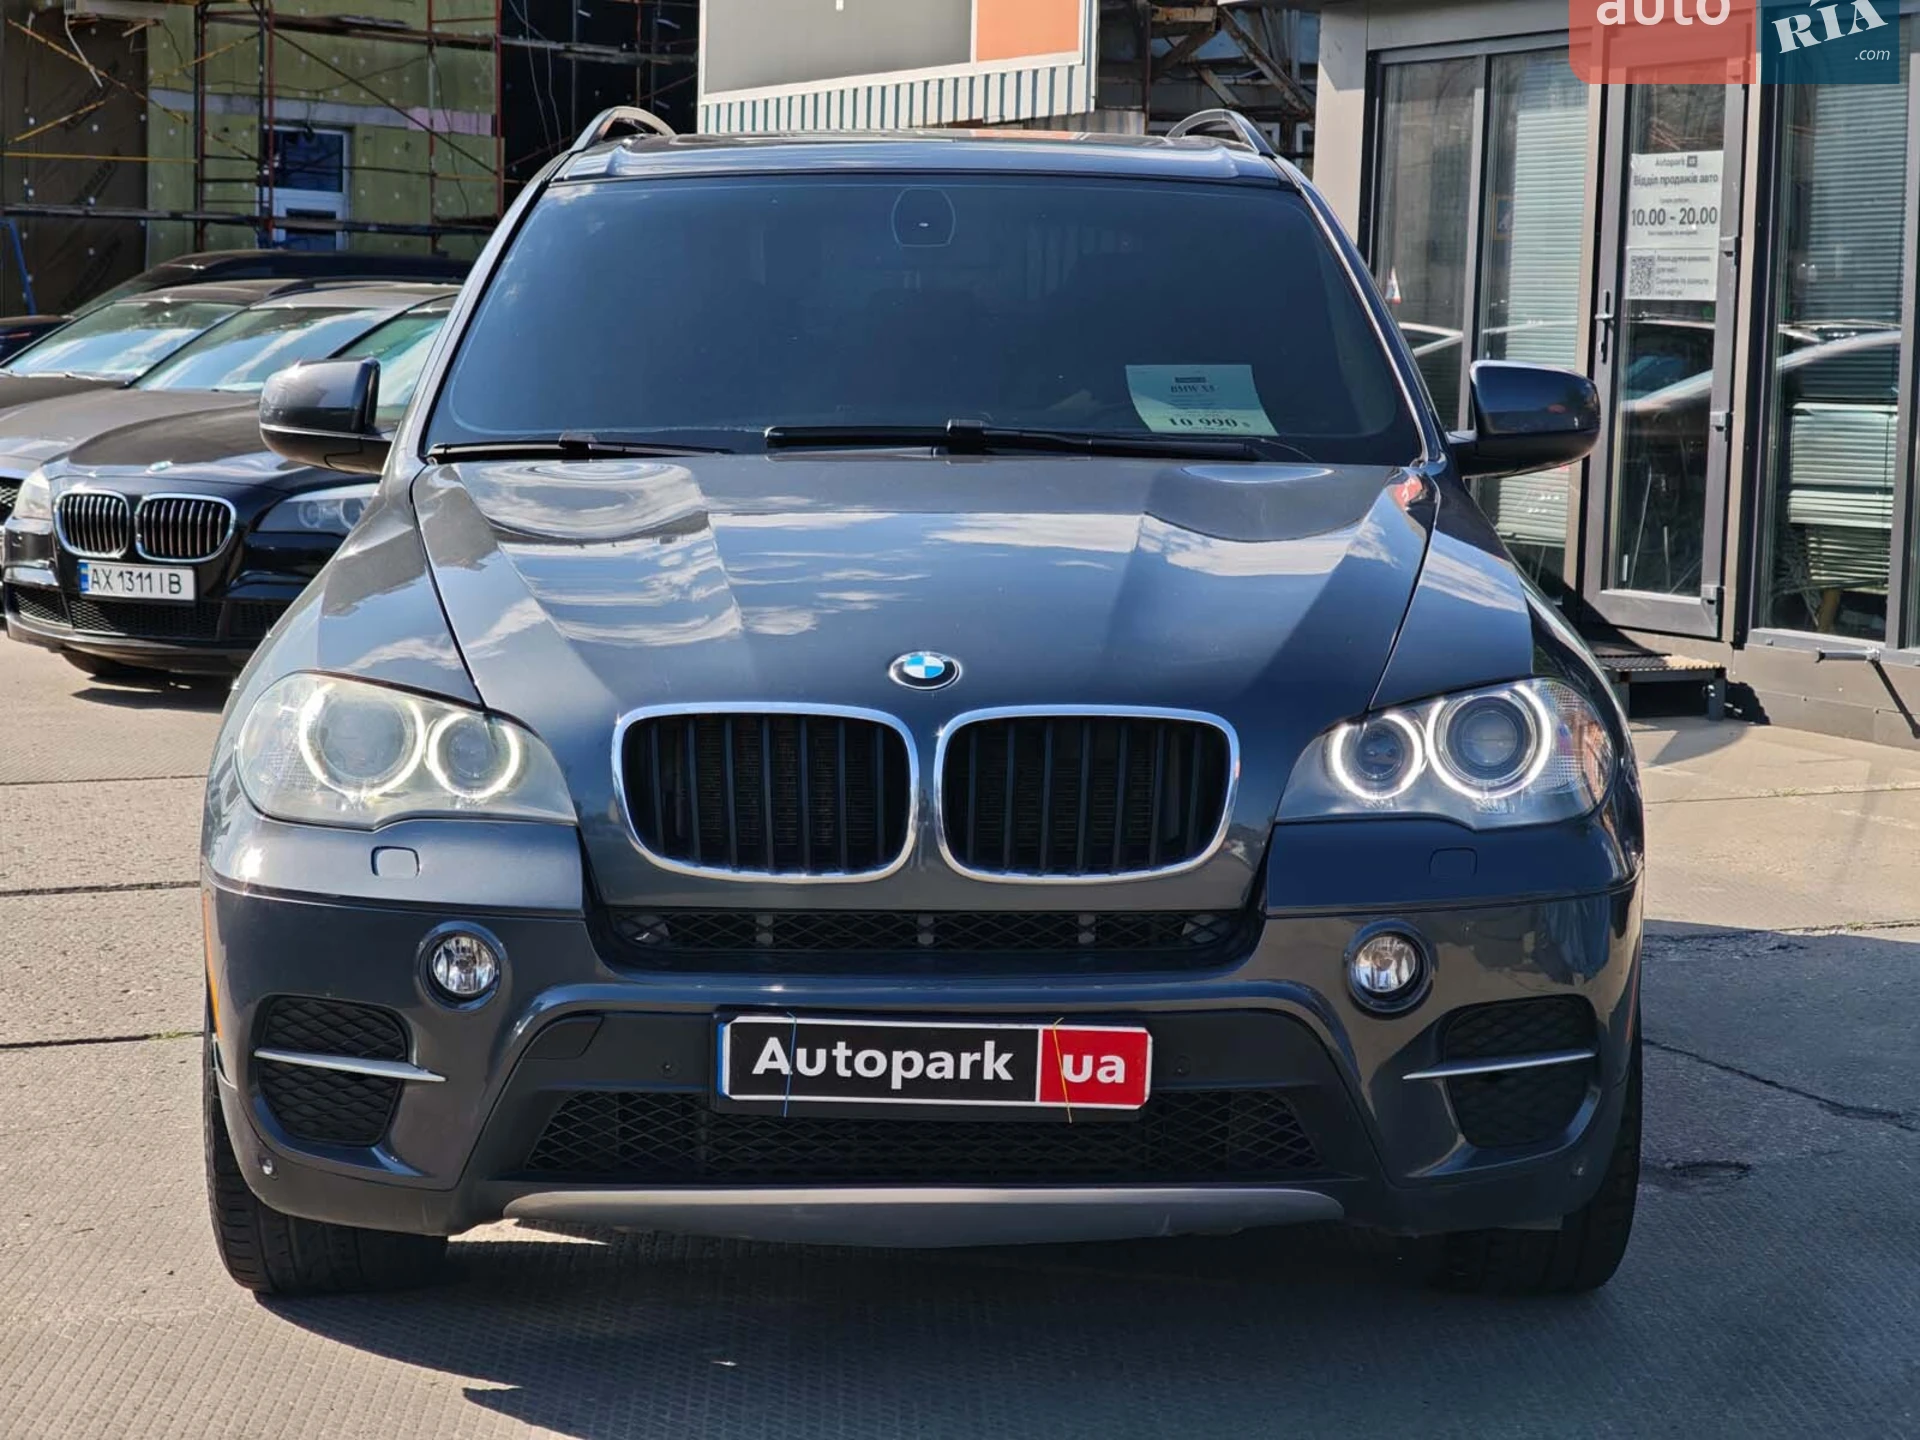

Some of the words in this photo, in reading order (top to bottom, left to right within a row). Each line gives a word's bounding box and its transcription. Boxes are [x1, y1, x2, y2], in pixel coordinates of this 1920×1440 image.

[1699, 174, 1719, 184] авто
[1632, 207, 1666, 226] 10.00
[1679, 206, 1718, 225] 20.00
[1169, 417, 1193, 426] 10
[1199, 418, 1237, 428] 990
[91, 568, 113, 592] AX
[117, 570, 153, 593] 1311
[159, 572, 182, 594] IB
[752, 1036, 1014, 1090] Autopark
[1062, 1053, 1126, 1085] ua
